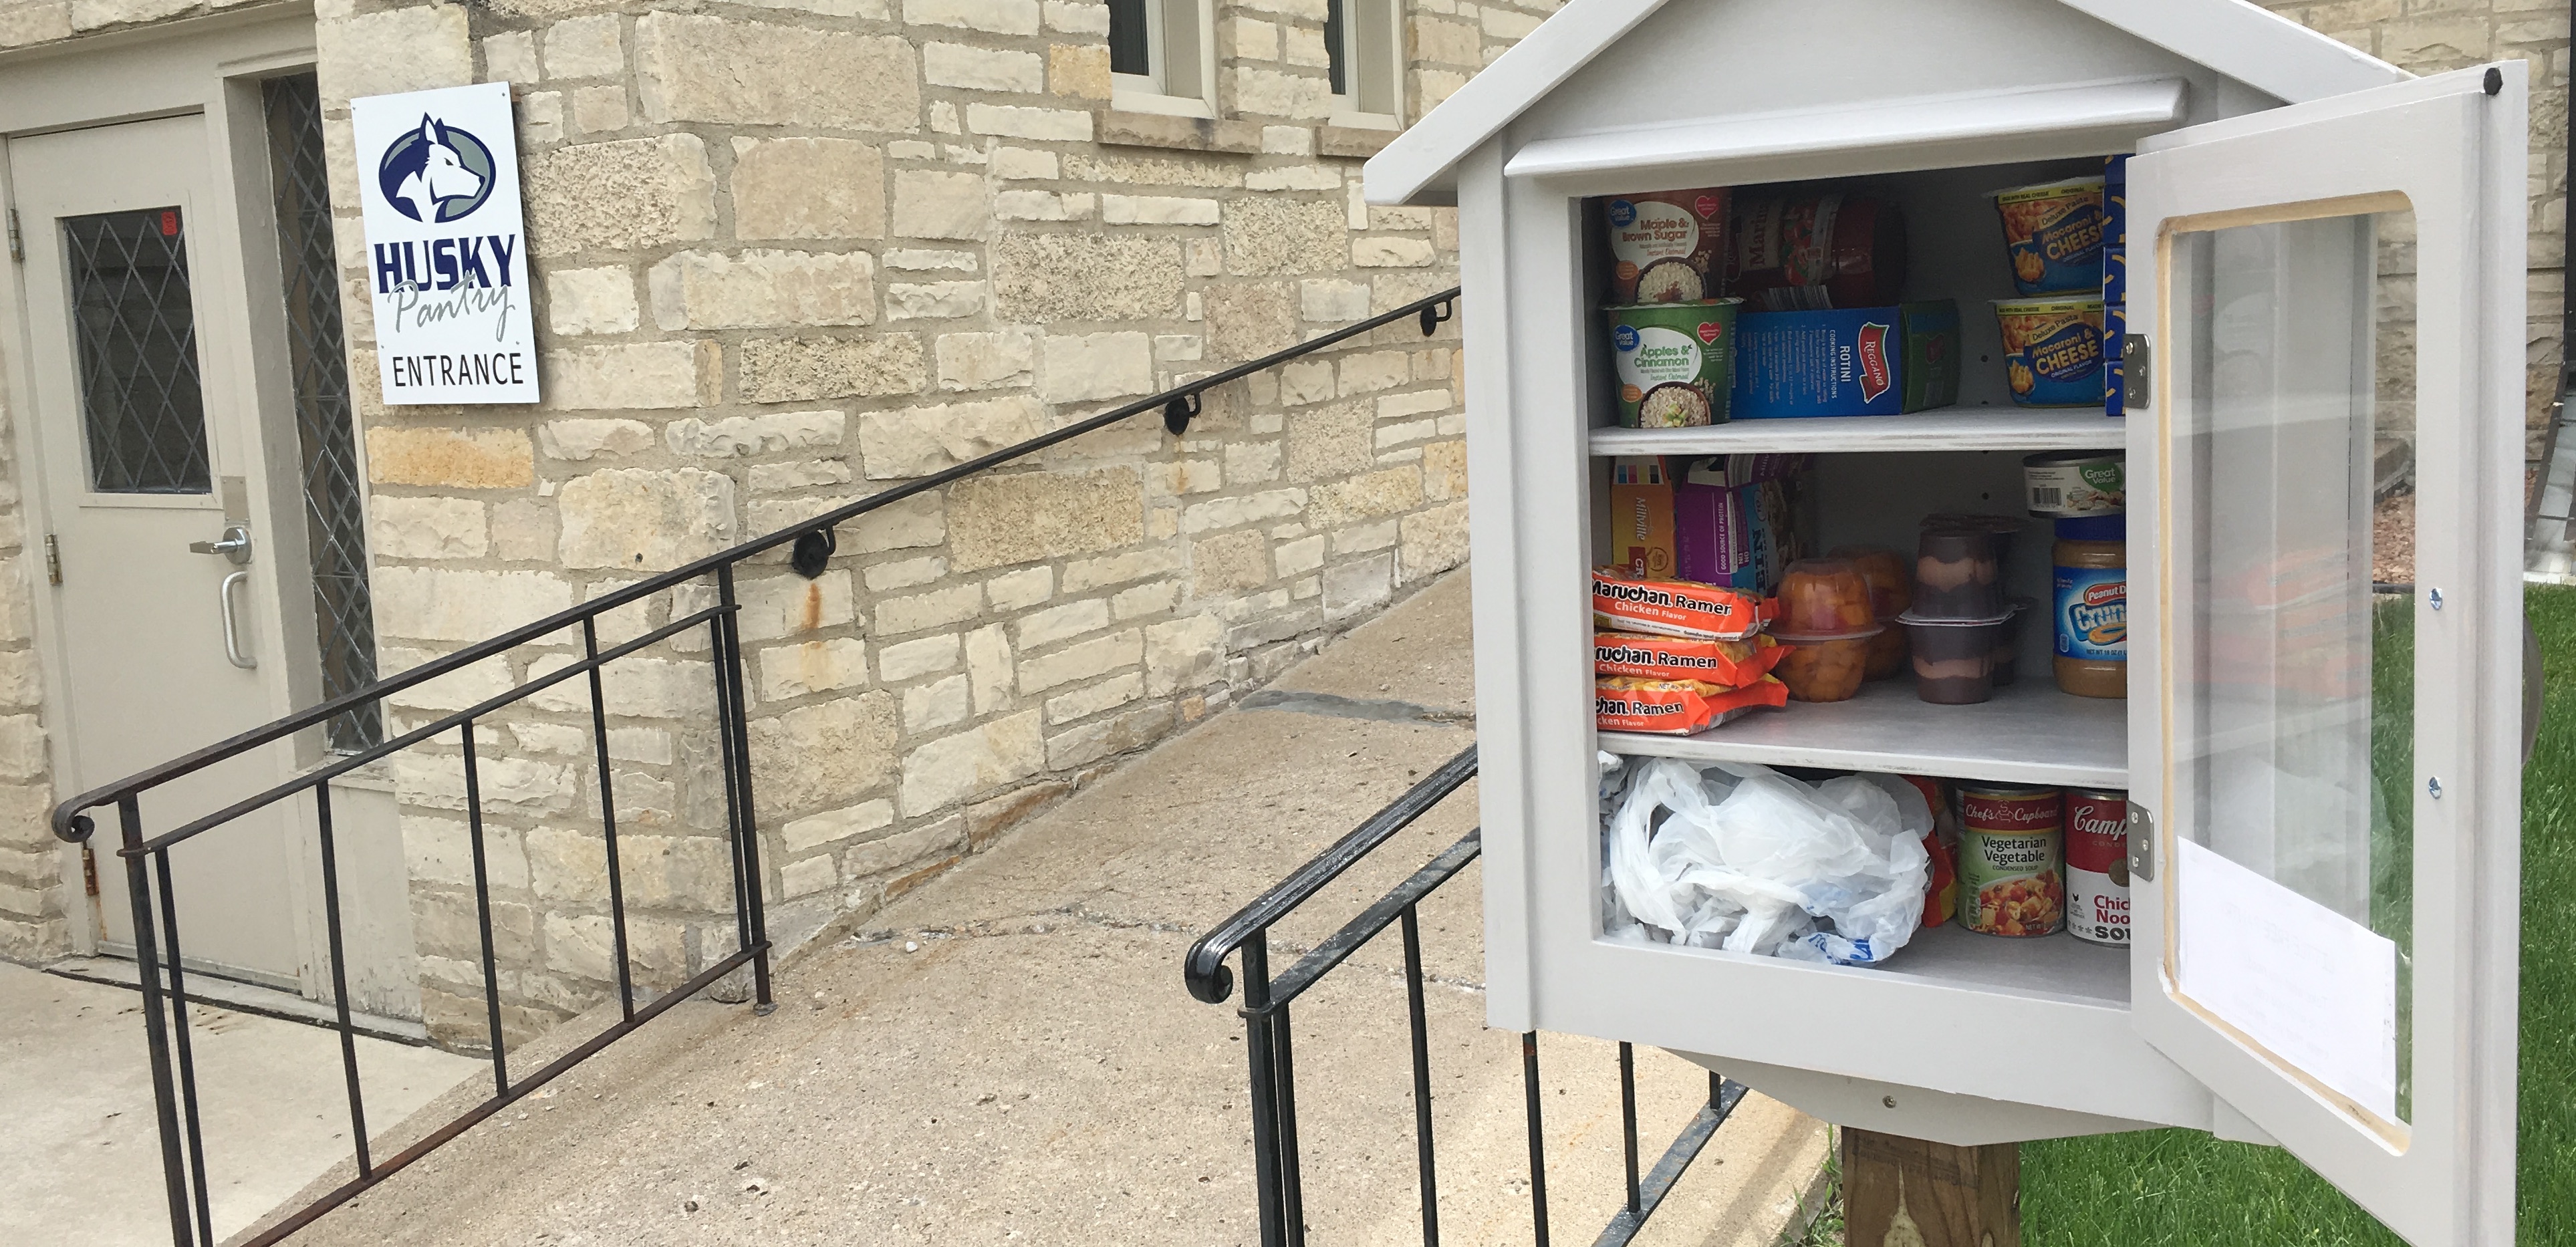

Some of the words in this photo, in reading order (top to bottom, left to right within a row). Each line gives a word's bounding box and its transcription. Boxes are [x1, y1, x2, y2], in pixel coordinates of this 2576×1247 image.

[1610, 205, 1630, 216] Great
[2041, 208, 2067, 226] Deluxe
[2066, 196, 2089, 210] Pasta
[1640, 219, 1678, 231] Maple
[1678, 218, 1688, 228] &
[2042, 214, 2092, 245] Macaroni
[1622, 231, 1652, 242] Brown
[1654, 230, 1687, 242] Sugar
[374, 234, 515, 294] HUSKY
[388, 270, 515, 342] Pantry
[1616, 331, 1633, 341] Great
[2032, 325, 2056, 341] Deluxe
[2054, 314, 2079, 327] Pasta
[1640, 345, 1678, 359] Apples
[1680, 345, 1690, 355] &
[2033, 332, 2081, 359] Macaroni
[2083, 328, 2094, 339] &
[1634, 357, 1689, 368] Cinnamon
[1840, 345, 1851, 382] ROTINI
[1865, 340, 1886, 386] REGGANO
[2036, 339, 2099, 375] CHEESE
[392, 353, 523, 388] ENTRANCE
[2085, 468, 2115, 479] Great
[1636, 497, 1646, 541] Millville
[1720, 524, 1725, 533] OF
[2088, 587, 2118, 601] Peanut
[1615, 601, 1659, 617] Chicken
[1662, 610, 1686, 621] Flavor
[1595, 646, 1653, 664] ruchan
[1658, 652, 1718, 668] Ramen
[1599, 664, 1643, 675] Chicken
[1632, 702, 1684, 716] Ramen
[1597, 716, 1620, 726] cken
[1622, 718, 1644, 727] Flavor
[1966, 804, 1995, 821] Chef's
[2014, 805, 2059, 824] Cupboard
[2074, 806, 2128, 841] Camp
[1981, 836, 2047, 853] Vegetarian
[1984, 849, 2045, 866] Vegetable
[2096, 909, 2130, 925] Noo
